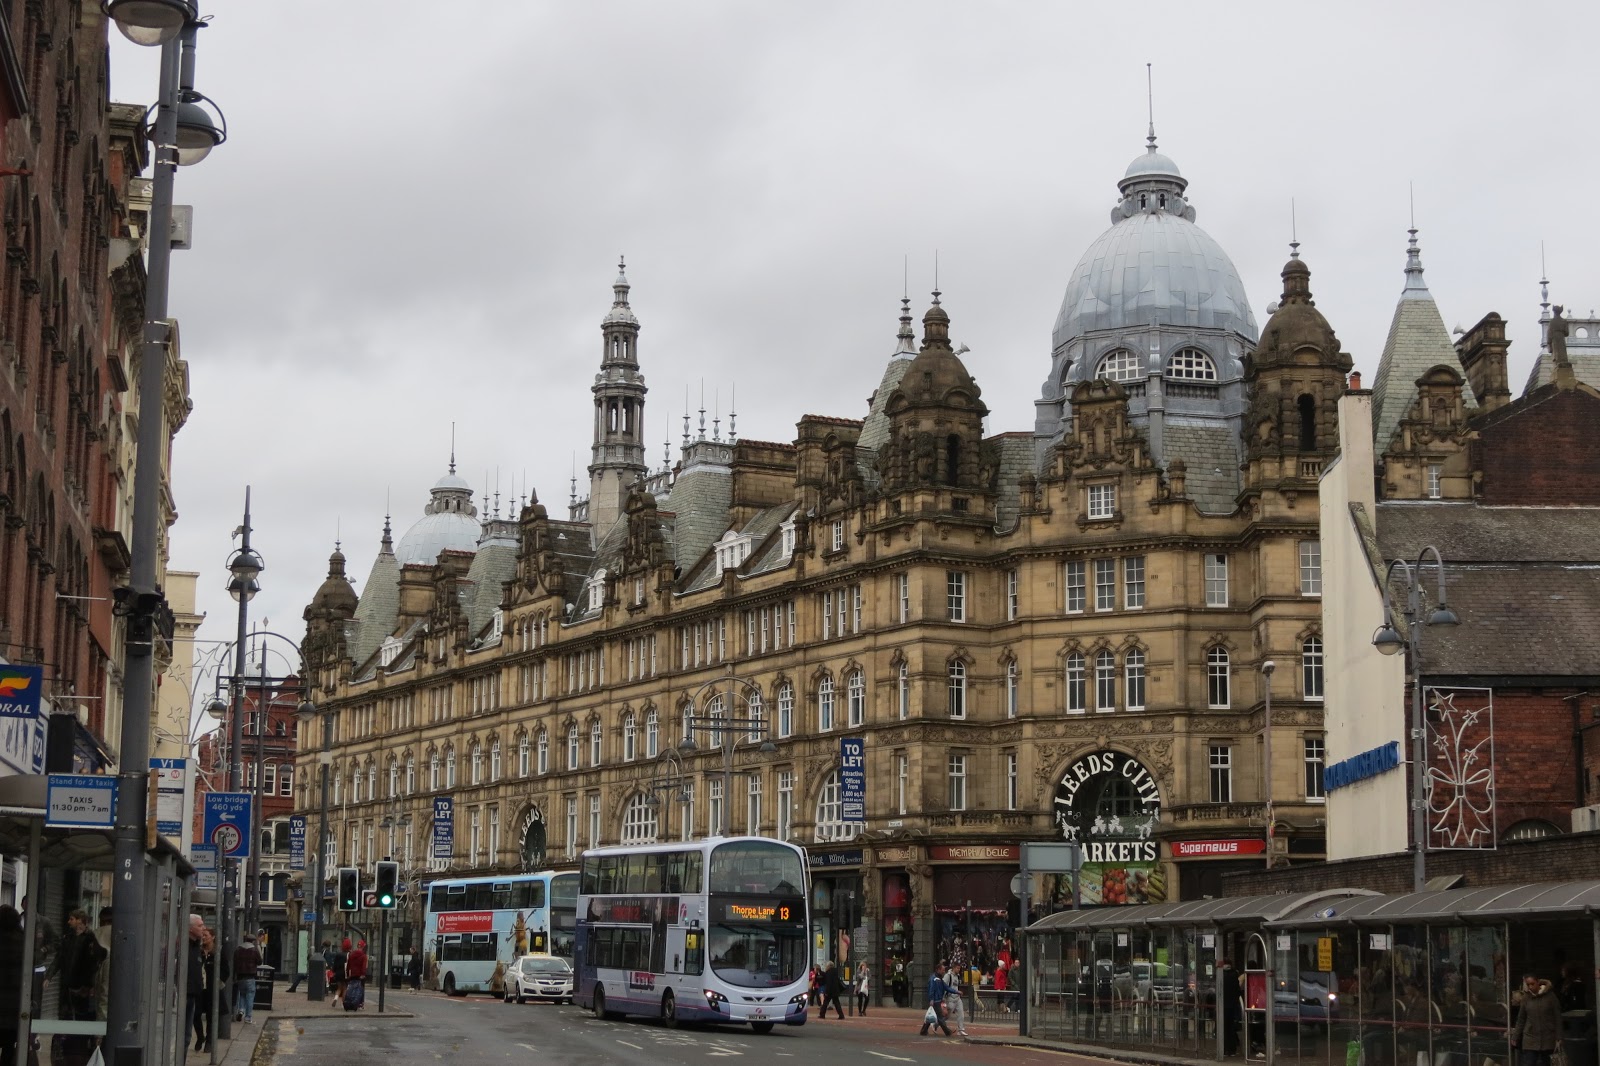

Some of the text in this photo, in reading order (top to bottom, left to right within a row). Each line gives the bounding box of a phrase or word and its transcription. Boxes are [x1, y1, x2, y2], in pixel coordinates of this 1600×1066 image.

[0, 703, 31, 714] RAL
[845, 744, 859, 755] TO
[161, 759, 174, 768] V1
[843, 756, 862, 767] LET
[50, 777, 72, 785] Stand
[75, 778, 85, 786] for
[1054, 752, 1160, 806] LEEDS CITY
[69, 796, 93, 804] TAXIS
[225, 796, 249, 804] bridge
[230, 803, 243, 812] yds
[437, 801, 449, 810] TO
[435, 811, 451, 819] LET
[290, 827, 304, 835] LET
[986, 847, 1010, 857] BELLE
[1081, 841, 1156, 862] ARKETS
[1180, 842, 1238, 854] Supernews
[829, 854, 846, 864] Bling
[732, 905, 789, 920] Thorpe Lane 13
